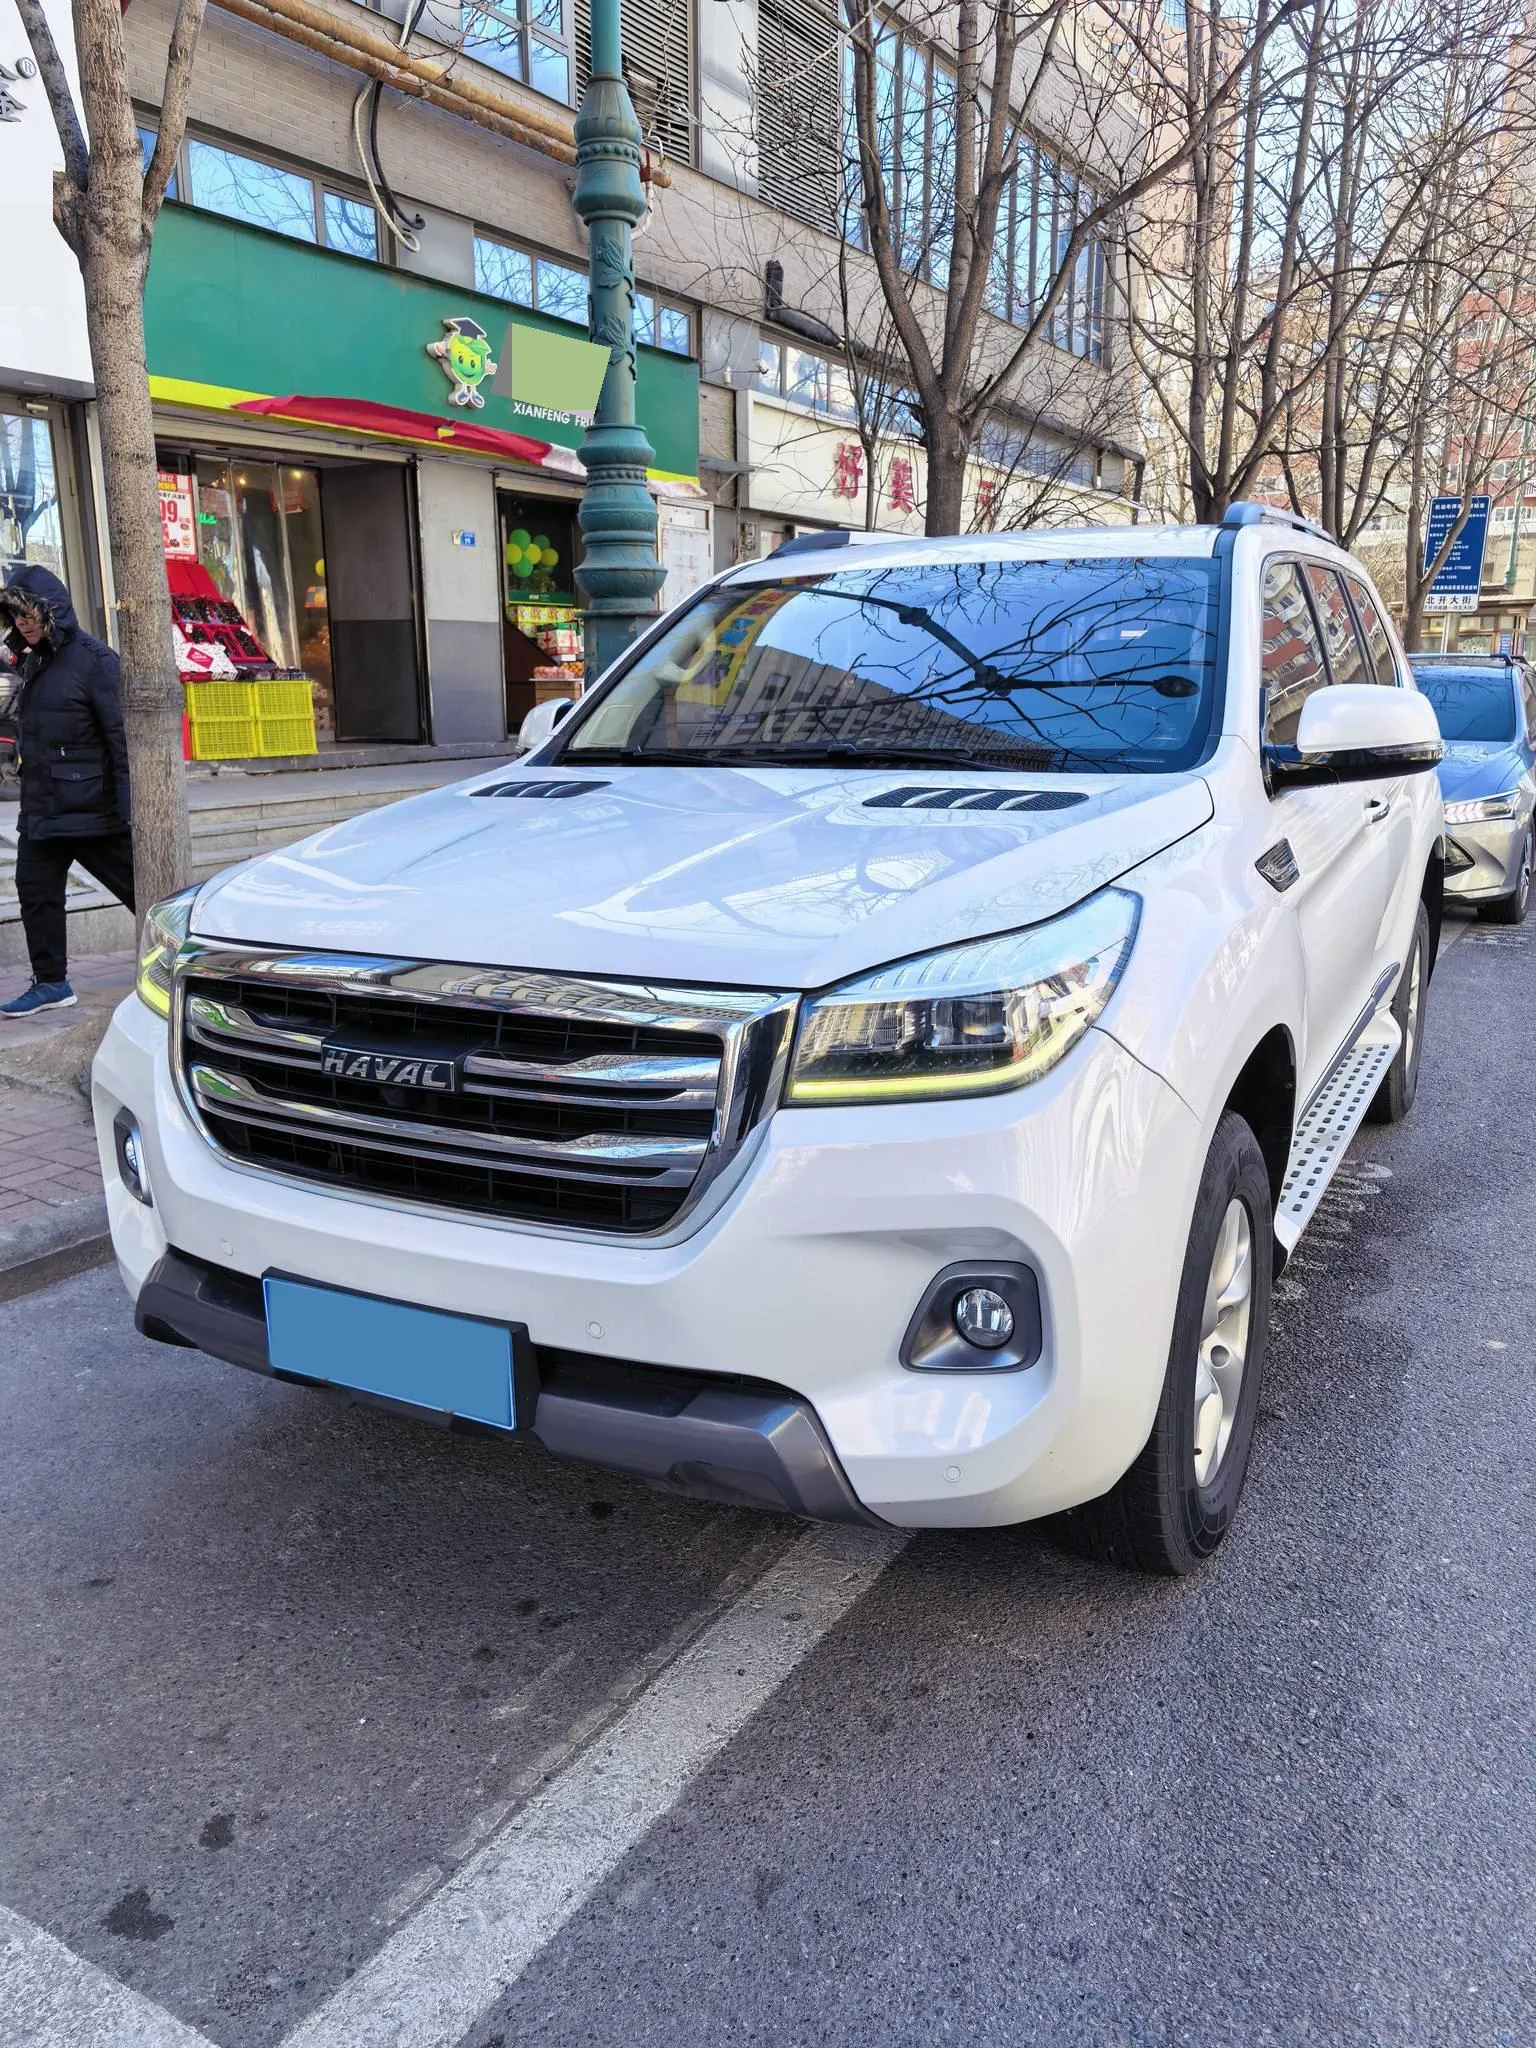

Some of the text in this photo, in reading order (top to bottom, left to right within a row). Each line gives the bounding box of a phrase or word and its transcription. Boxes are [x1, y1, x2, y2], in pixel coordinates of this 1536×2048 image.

[513, 401, 570, 424] XIANFENG
[1426, 595, 1472, 605] 北开大街
[323, 1050, 447, 1088] HAVAL
